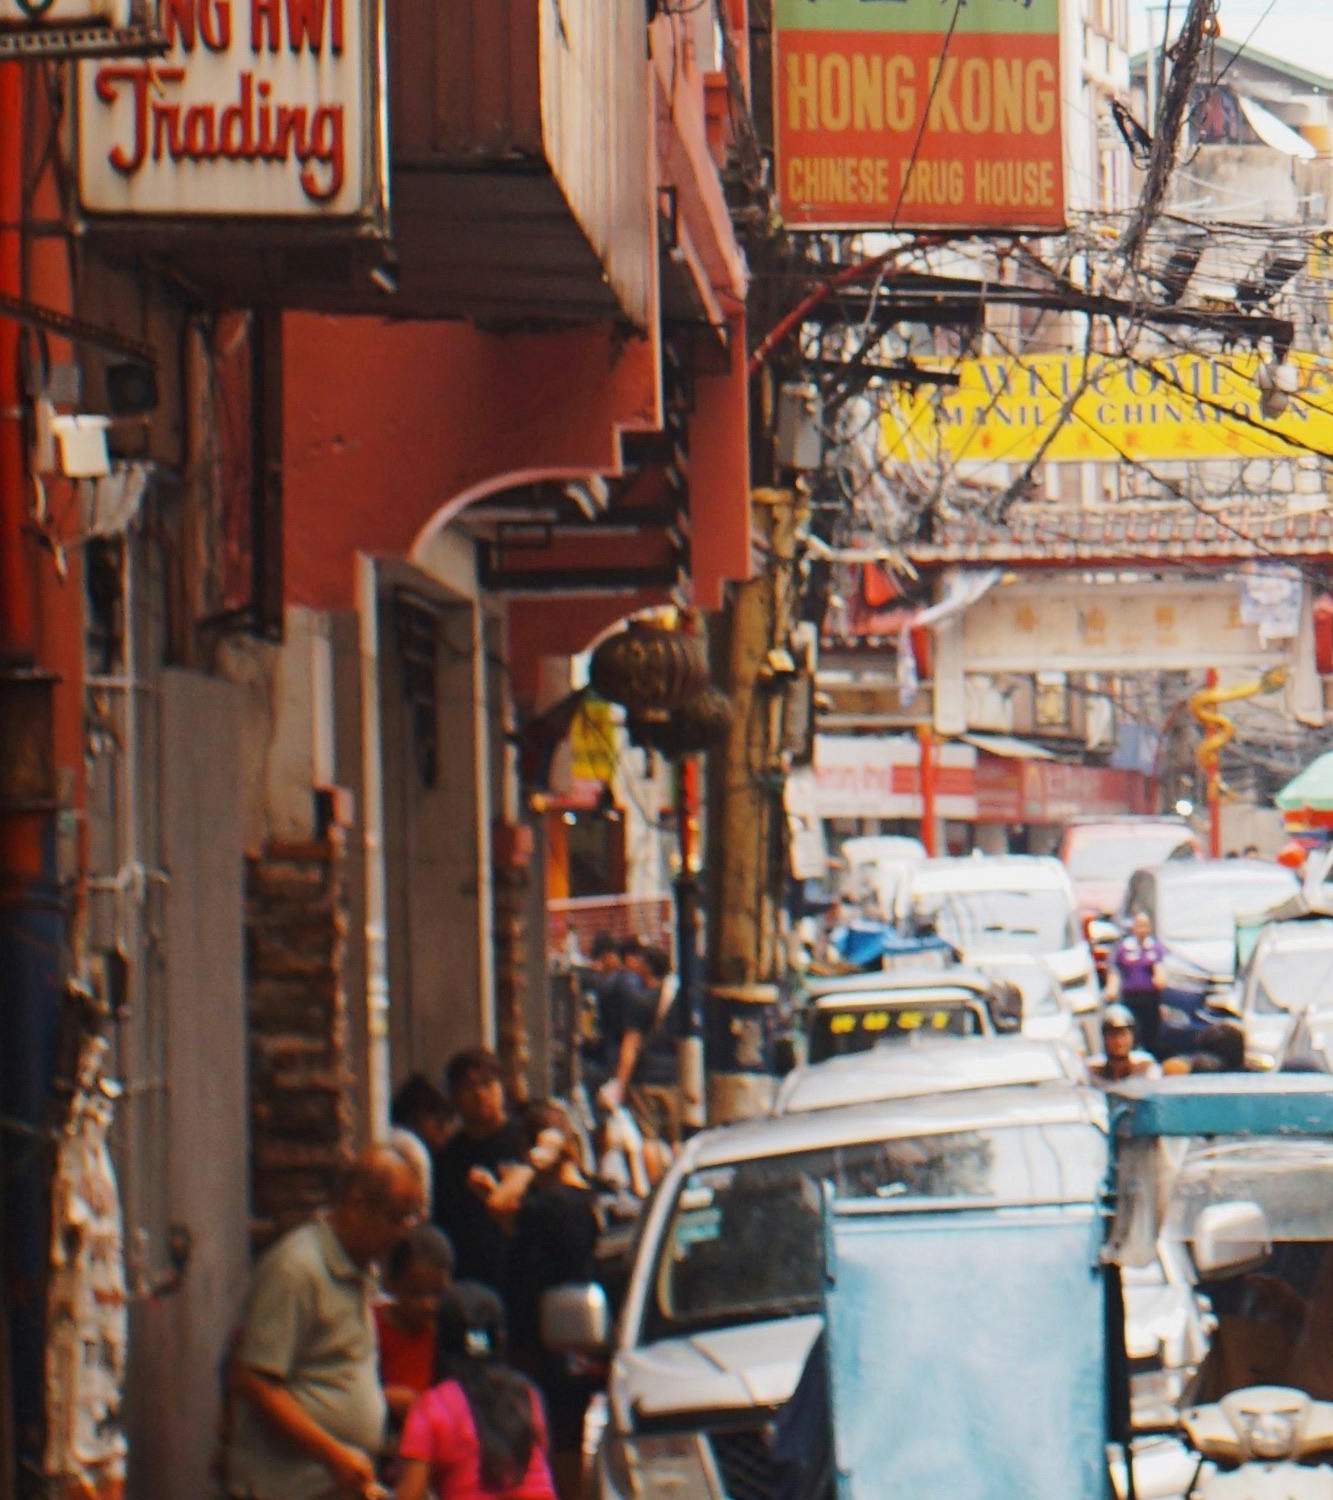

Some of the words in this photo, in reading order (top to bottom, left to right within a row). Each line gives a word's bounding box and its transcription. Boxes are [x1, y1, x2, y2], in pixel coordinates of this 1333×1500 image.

[785, 53, 916, 134] HONG
[927, 55, 1056, 136] KONG
[96, 66, 344, 201] Trading
[787, 156, 889, 204] CHINESE
[902, 159, 966, 205] DRUG
[974, 160, 1055, 207] HOUSE
[977, 359, 1240, 399] WELCOME
